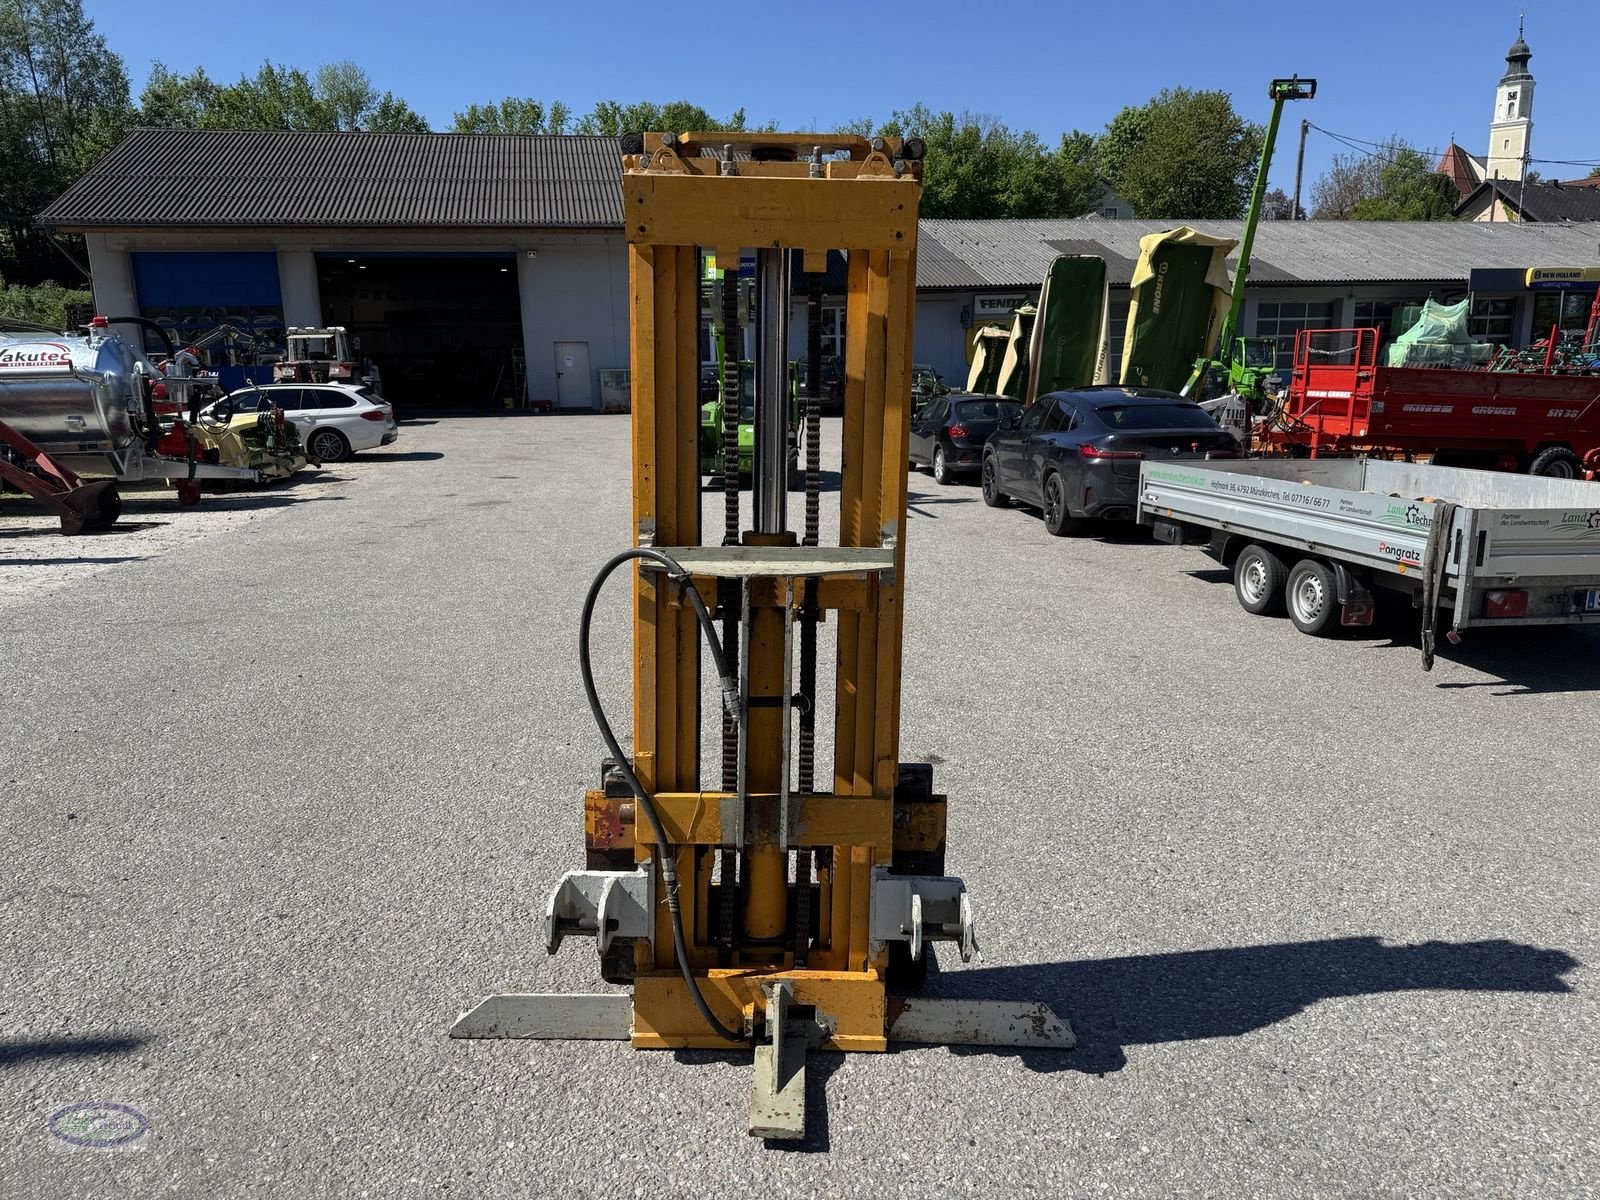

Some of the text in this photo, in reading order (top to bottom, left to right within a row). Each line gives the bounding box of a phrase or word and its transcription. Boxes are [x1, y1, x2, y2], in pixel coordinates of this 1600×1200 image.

[1542, 271, 1581, 279] NEW HOLLAND
[1153, 275, 1165, 314] KRONE
[980, 298, 1020, 309] FEND
[1097, 341, 1109, 373] KRONE
[1472, 406, 1518, 416] GRUBER
[1211, 480, 1229, 490] Hofmark
[1237, 484, 1250, 494] 4792
[1386, 503, 1407, 515] Land
[1561, 511, 1588, 523] Land
